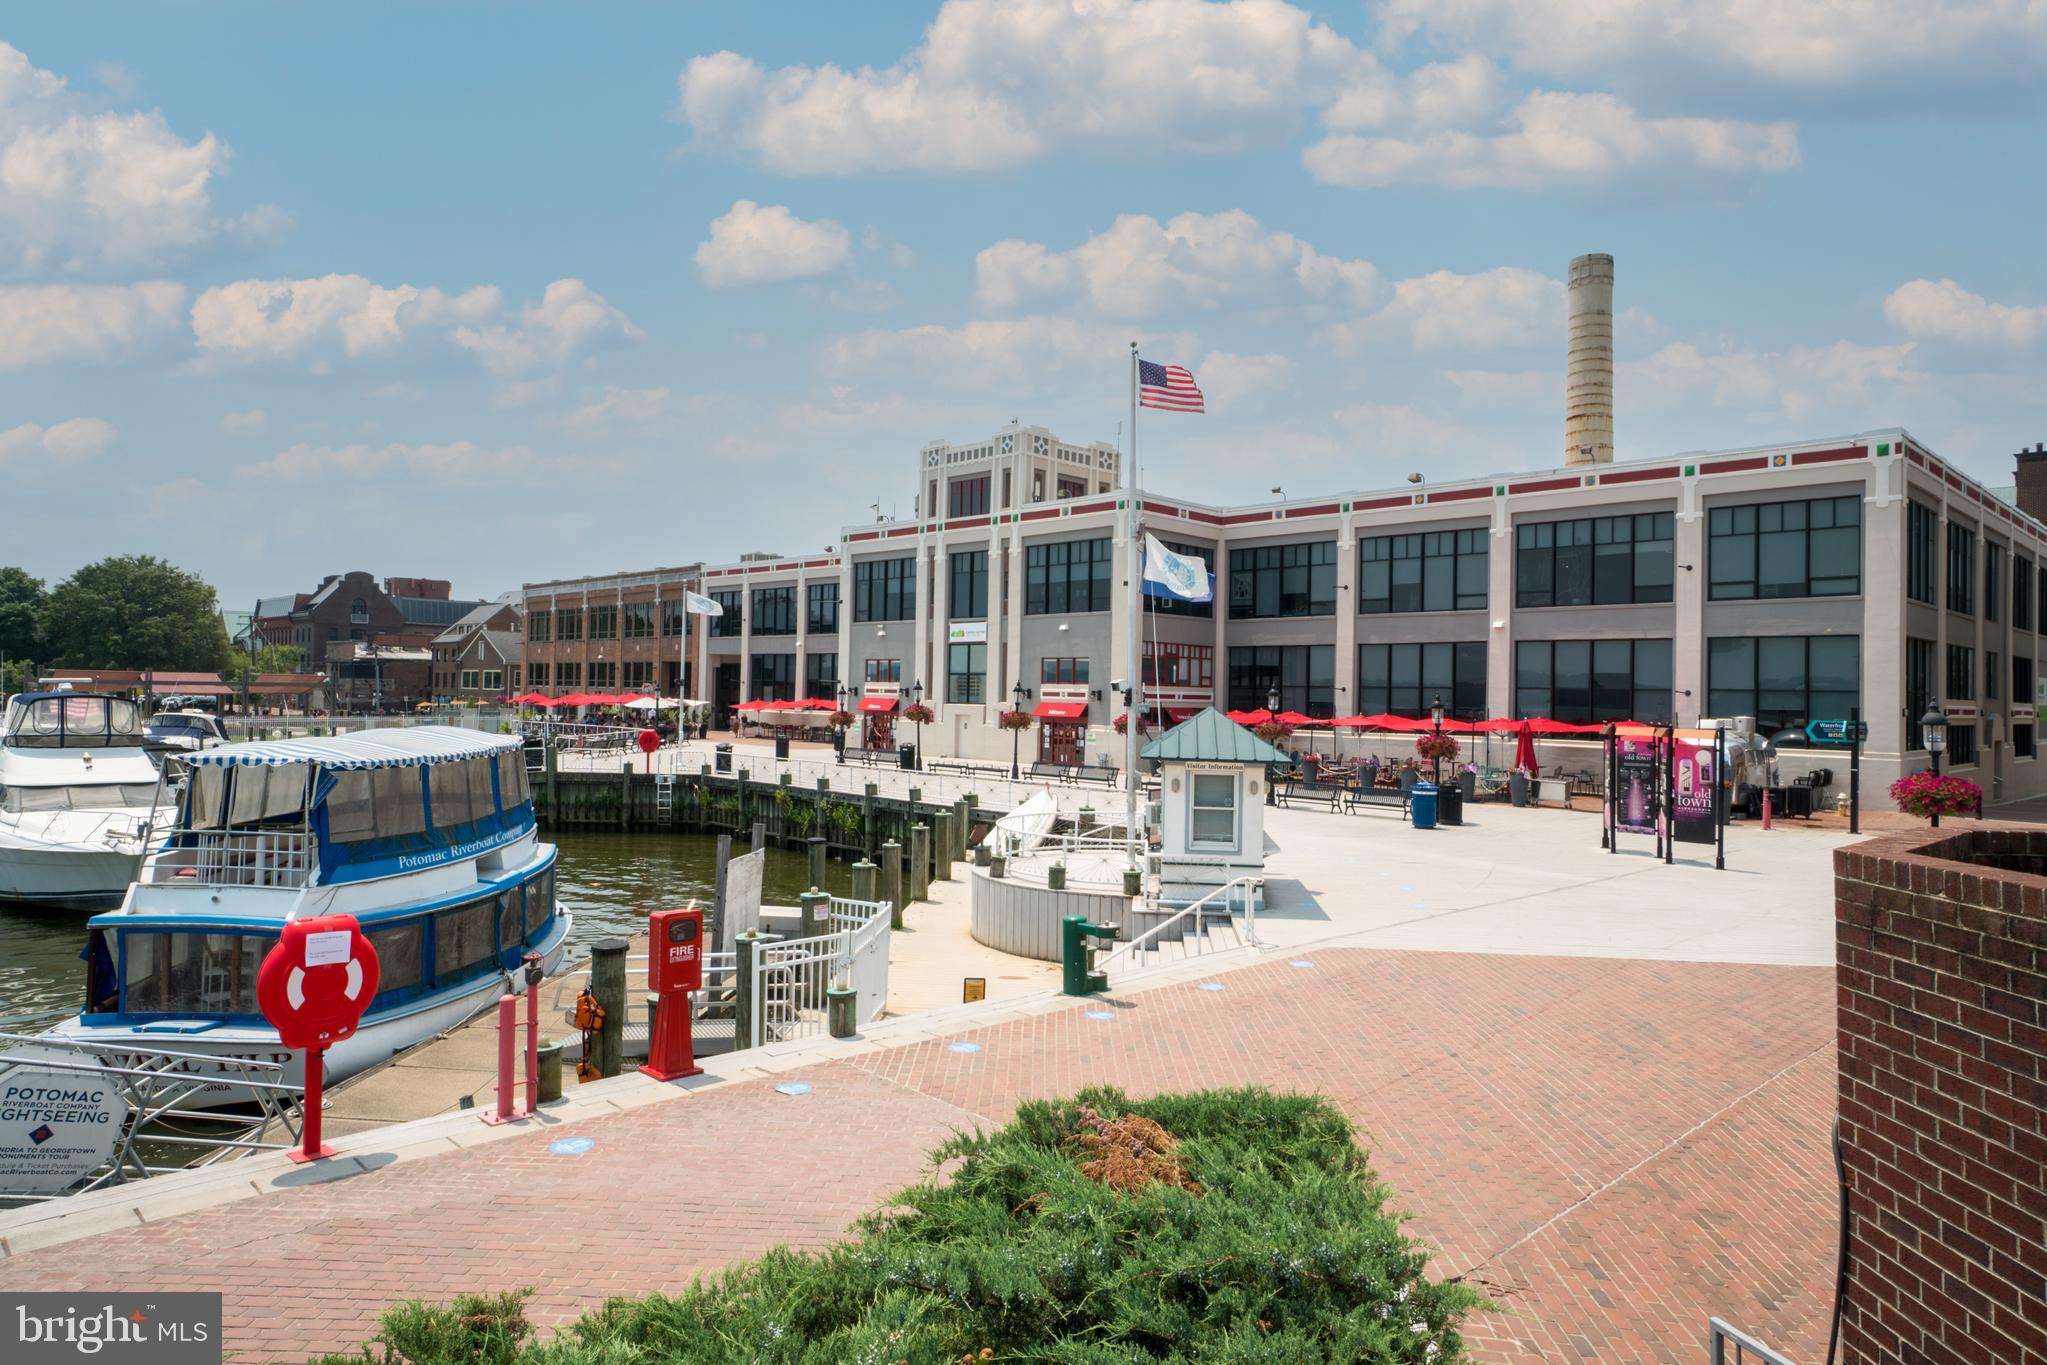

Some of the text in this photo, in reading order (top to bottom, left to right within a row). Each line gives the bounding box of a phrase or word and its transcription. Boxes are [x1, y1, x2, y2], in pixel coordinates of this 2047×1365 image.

[1694, 787, 1712, 799] old
[1677, 794, 1713, 808] town
[398, 850, 448, 869] Potomac
[450, 836, 495, 858] Riverboat
[670, 945, 694, 957] FIRE
[5, 1087, 104, 1103] POTOMAC
[2, 1100, 101, 1110] RIVERBOAT COMPANY
[0, 1108, 110, 1124] GHTSEEING
